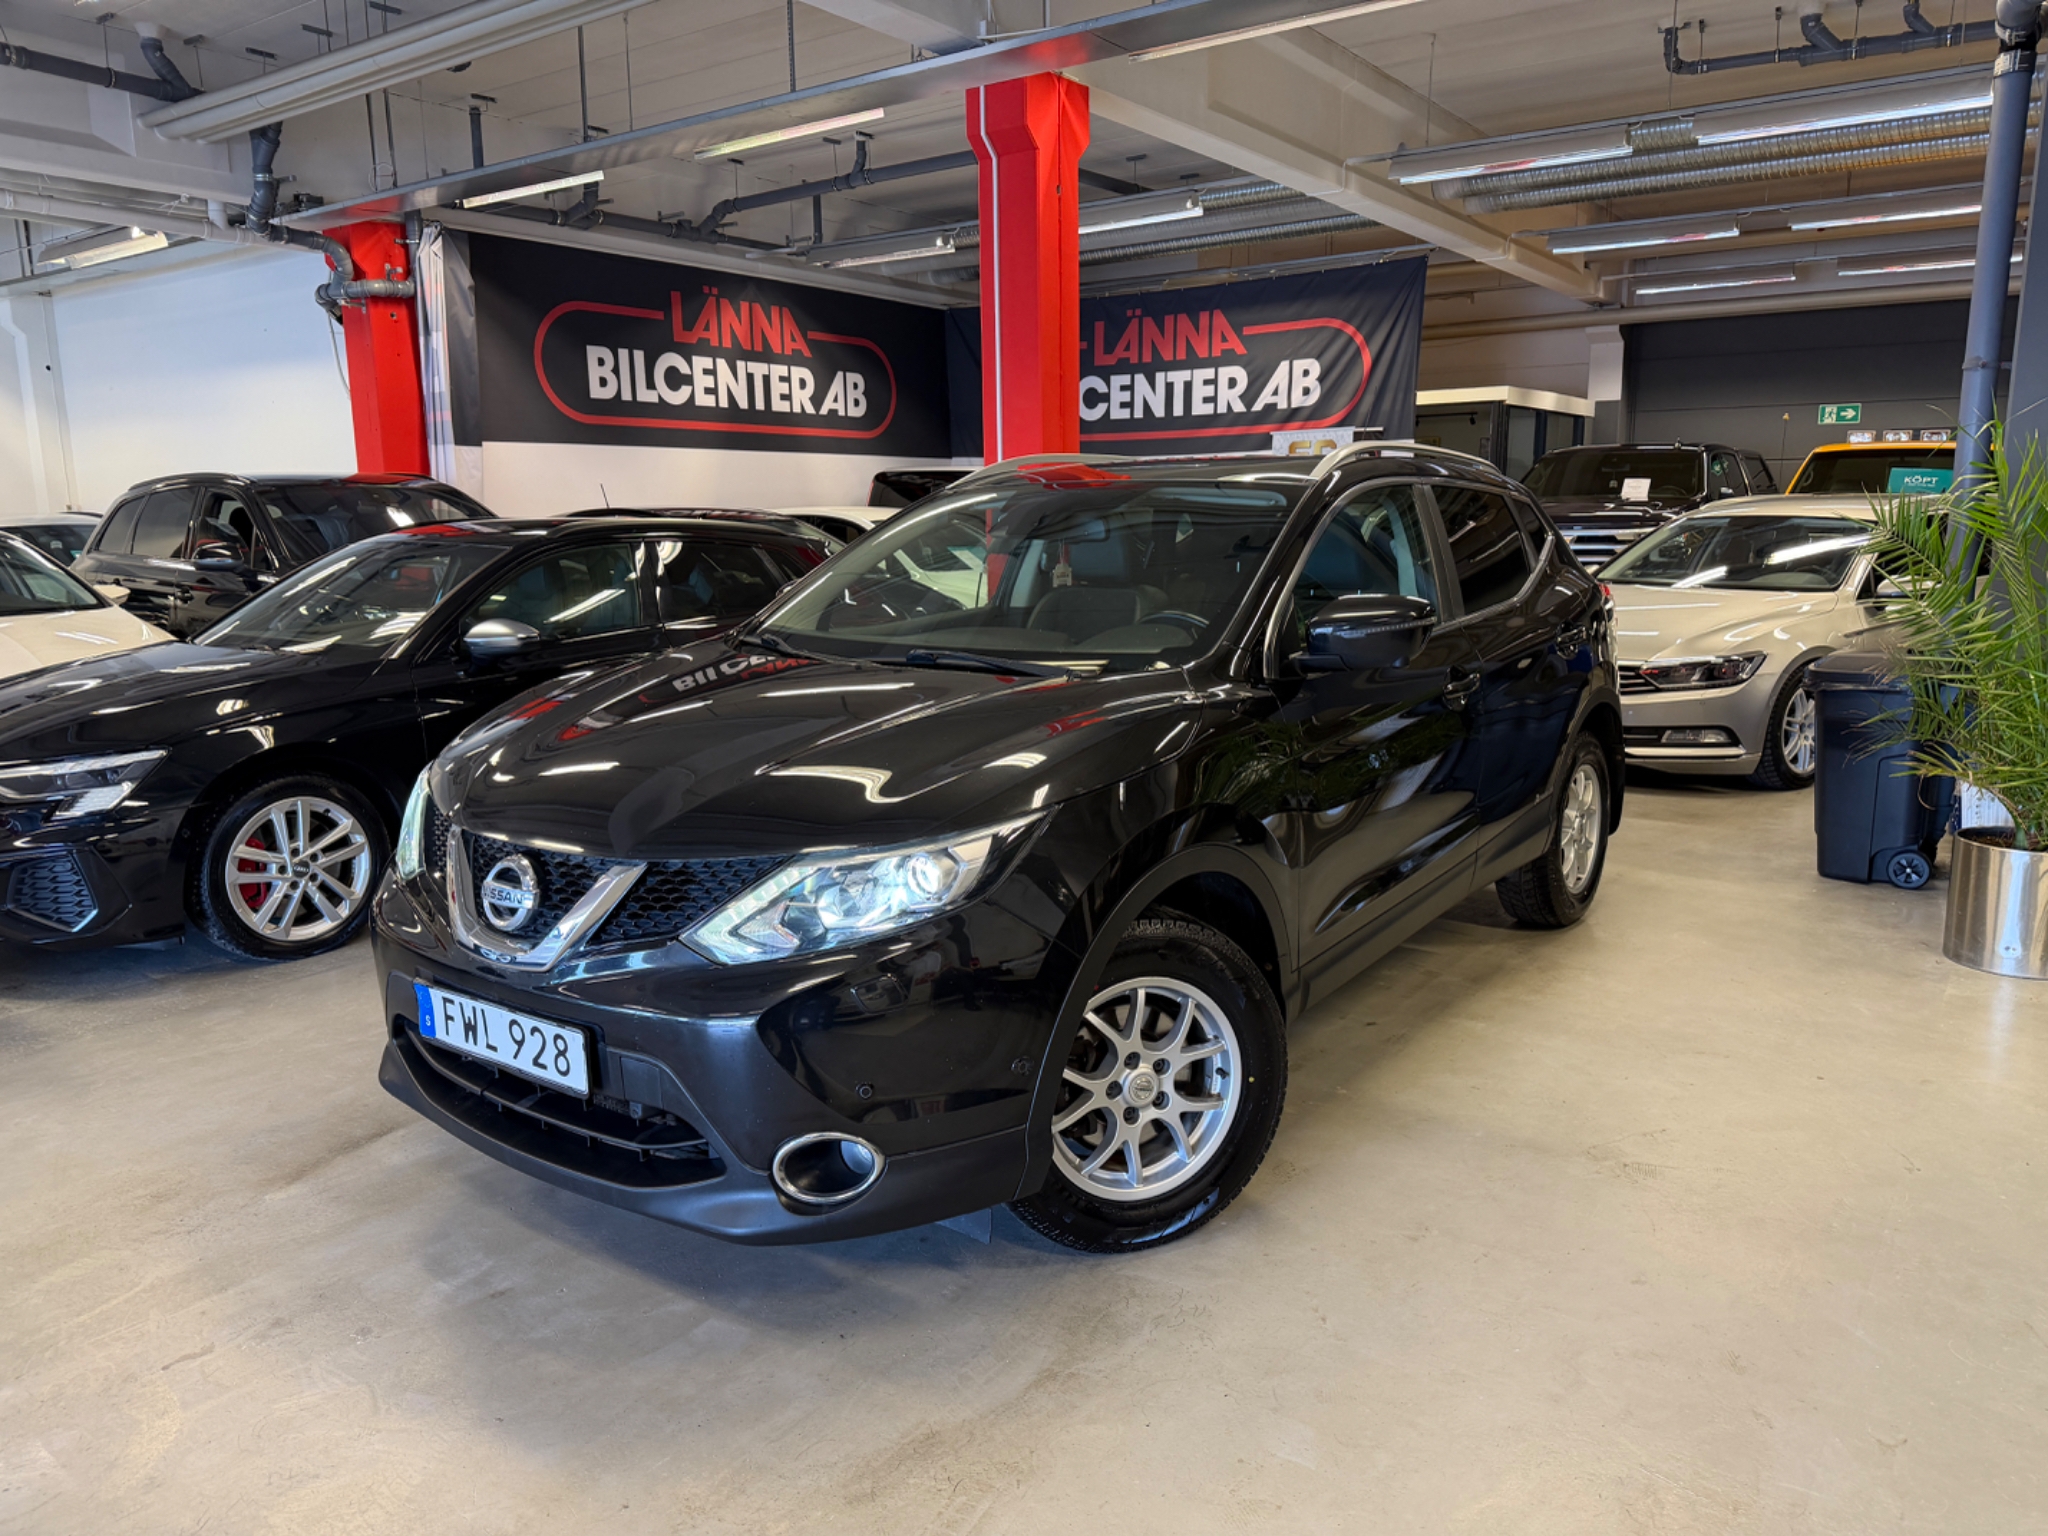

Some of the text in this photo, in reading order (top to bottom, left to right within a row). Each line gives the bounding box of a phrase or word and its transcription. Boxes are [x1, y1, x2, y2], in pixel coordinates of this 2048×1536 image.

[670, 285, 813, 358] LÄNNA
[1093, 308, 1247, 366] LÄNNA
[586, 345, 868, 418] BILCENTER AB
[1251, 358, 1322, 411] AB
[426, 1015, 431, 1026] S
[442, 996, 571, 1077] FWL 928
